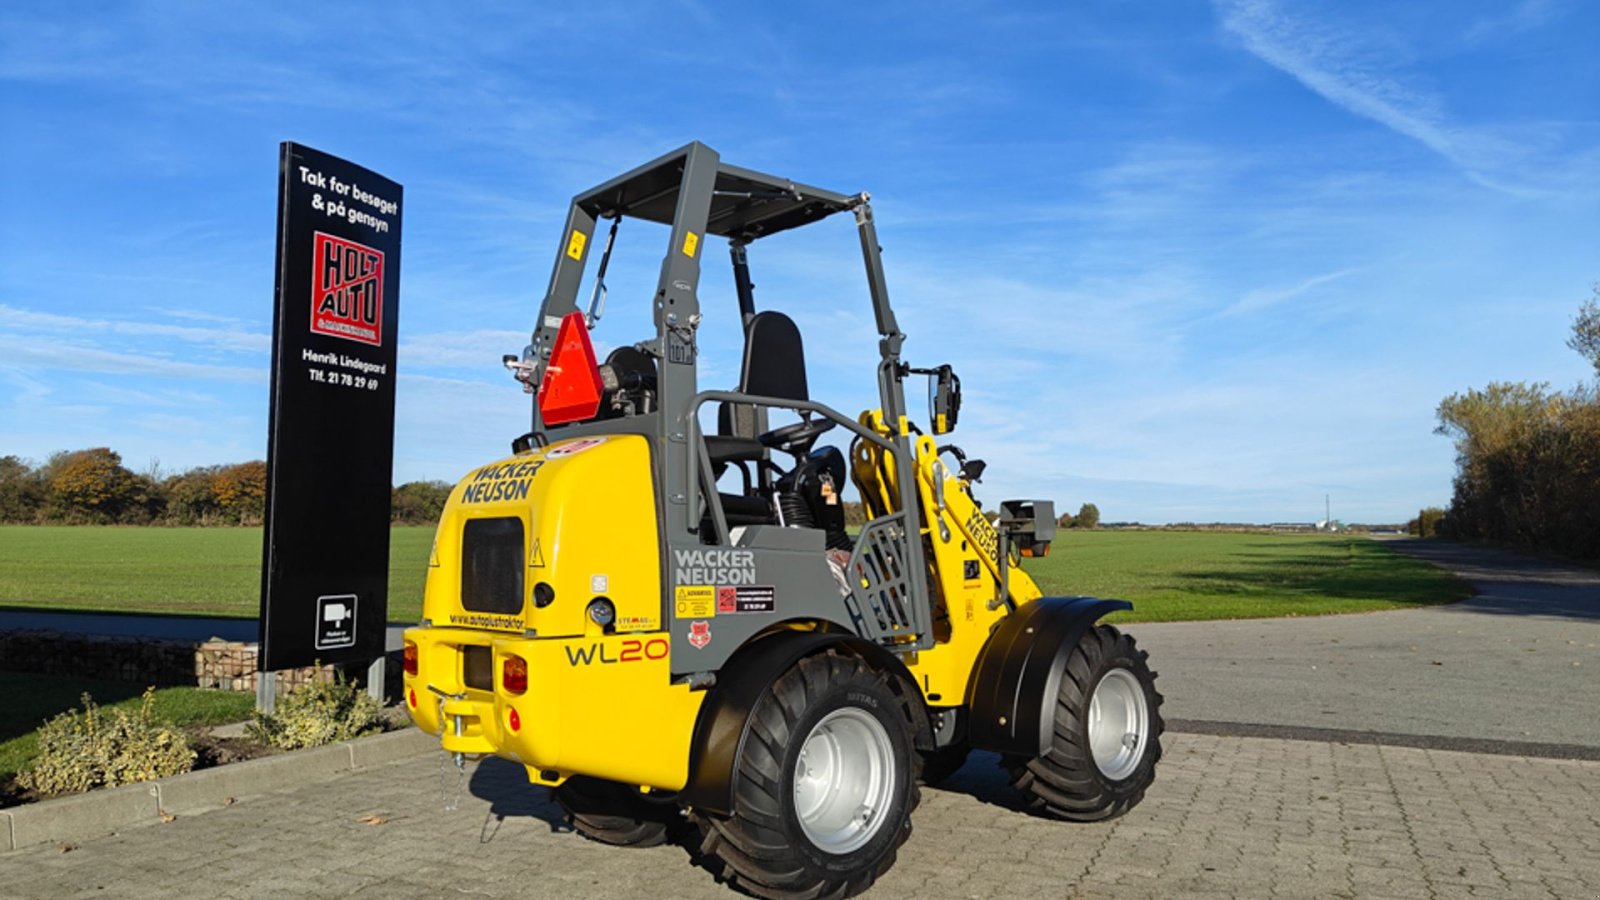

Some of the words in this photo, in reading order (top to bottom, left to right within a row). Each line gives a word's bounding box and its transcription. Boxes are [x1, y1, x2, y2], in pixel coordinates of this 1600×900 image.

[299, 166, 326, 189] Tak
[329, 176, 350, 196] for
[352, 183, 398, 215] besøget
[311, 193, 325, 211] &
[326, 201, 346, 217] på
[347, 208, 388, 233] gensyn
[323, 241, 378, 291] HOLT
[319, 278, 377, 324] AUTO
[302, 348, 338, 365] Henrik
[340, 355, 387, 375] Lindegaard
[327, 371, 339, 384] 21
[341, 373, 353, 386] 78
[354, 376, 366, 388] 29
[367, 379, 379, 391] 69
[473, 460, 545, 481] WACKER
[461, 479, 533, 504] NEUSON
[965, 517, 999, 563] NEUSO
[675, 550, 755, 567] WACKER
[676, 568, 756, 585] NEUSON
[565, 639, 669, 667] WL20
